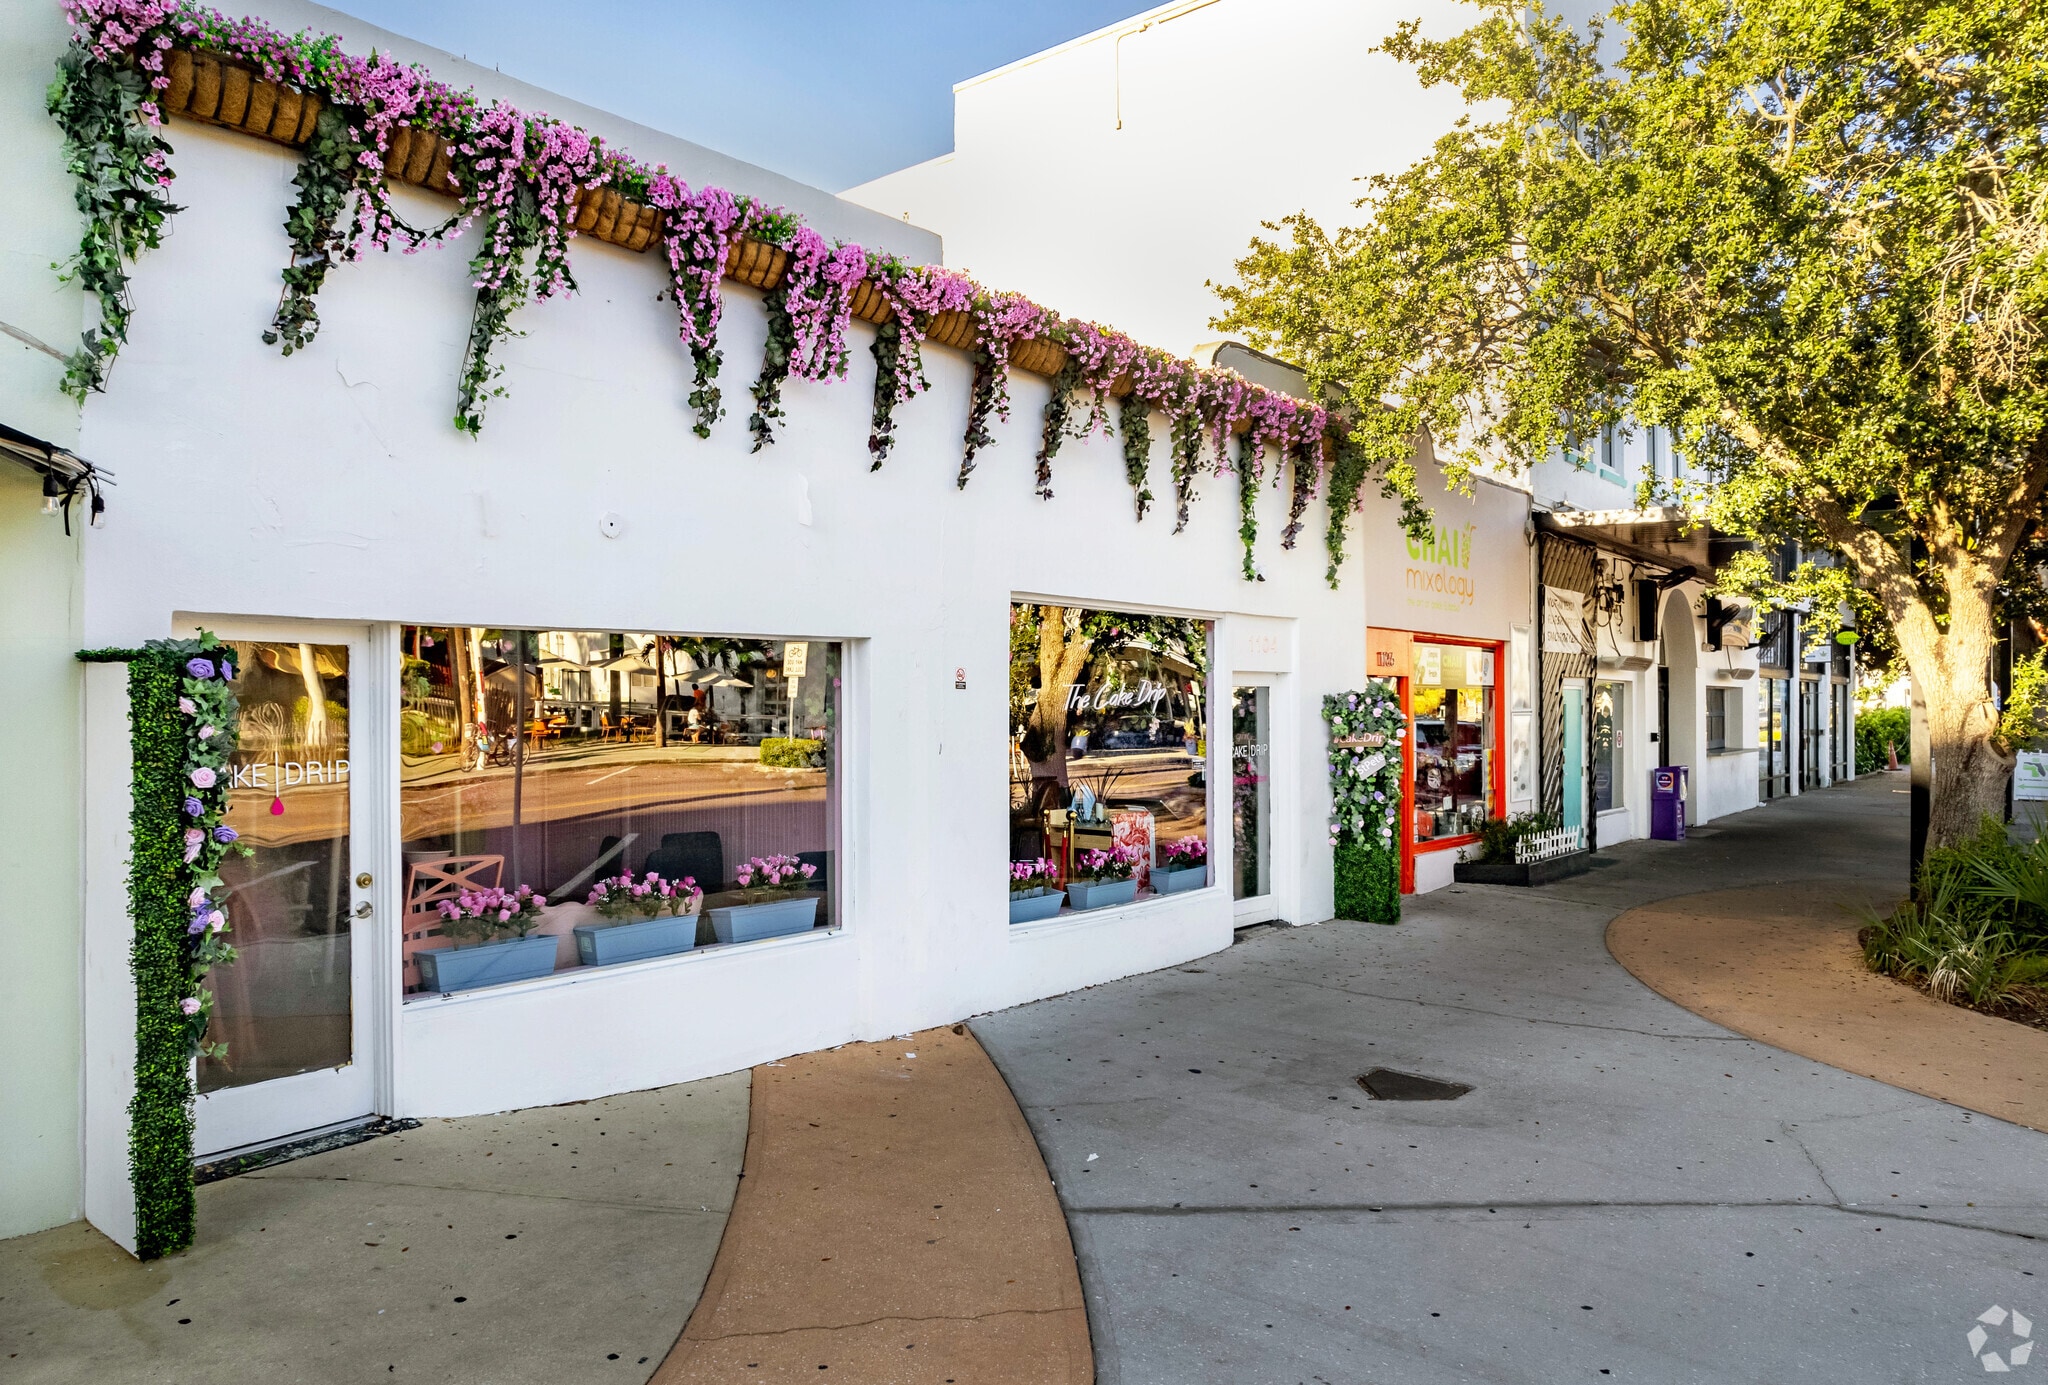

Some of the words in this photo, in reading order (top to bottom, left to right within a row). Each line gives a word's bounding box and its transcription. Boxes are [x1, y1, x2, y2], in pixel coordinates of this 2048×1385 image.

[1405, 524, 1459, 568] CHAI
[1406, 566, 1475, 606] mixology
[1062, 684, 1091, 711] The
[1093, 683, 1134, 710] Cake
[1134, 679, 1167, 714] Drip
[1231, 744, 1248, 758] CAKE
[1251, 744, 1268, 757] DRIP
[219, 763, 268, 791] AKE
[285, 759, 350, 785] DRIP
